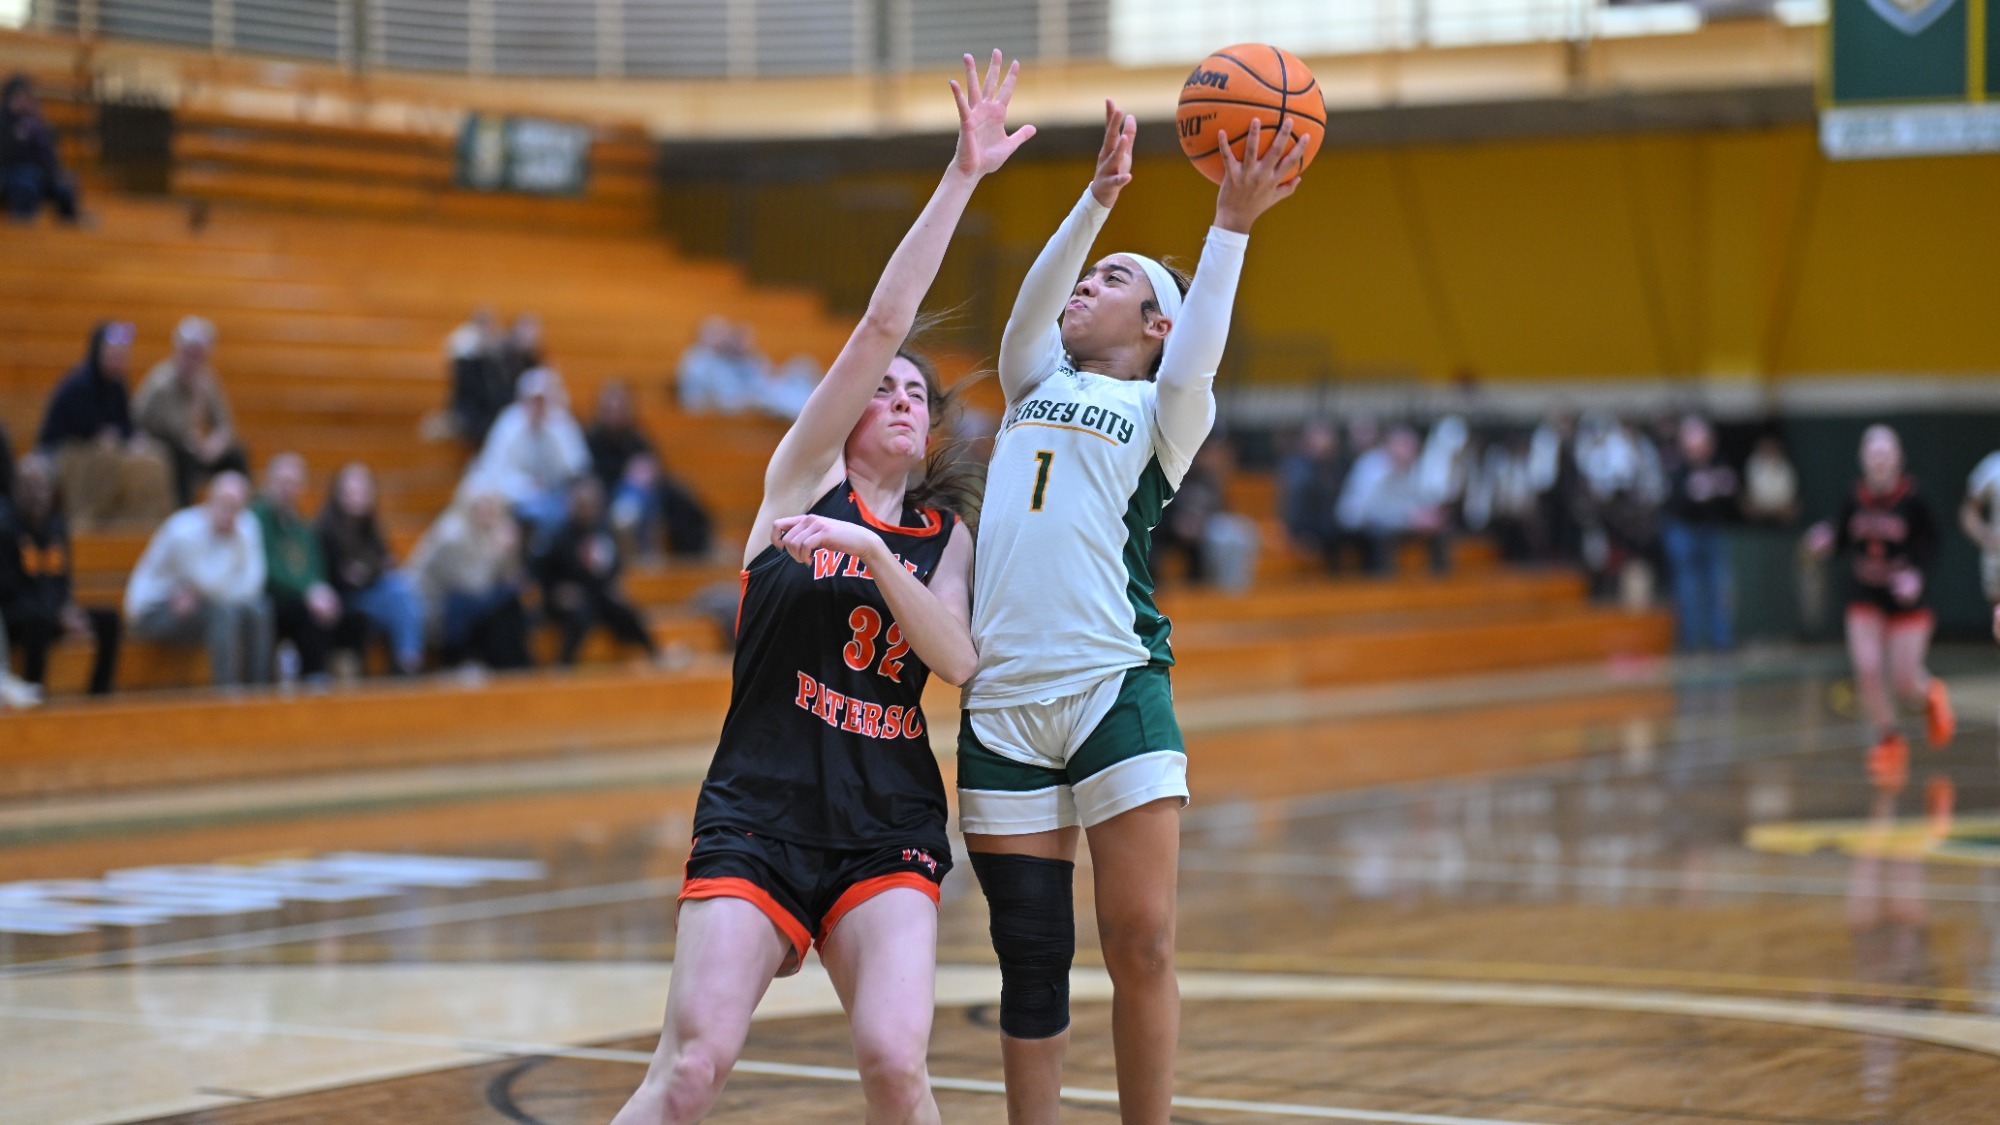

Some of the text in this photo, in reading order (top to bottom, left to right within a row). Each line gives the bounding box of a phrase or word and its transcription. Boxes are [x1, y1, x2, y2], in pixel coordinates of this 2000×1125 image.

[1080, 405, 1135, 444] CITY
[1029, 449, 1055, 512] 1
[843, 605, 911, 684] 32
[795, 670, 926, 740] PATERSO
